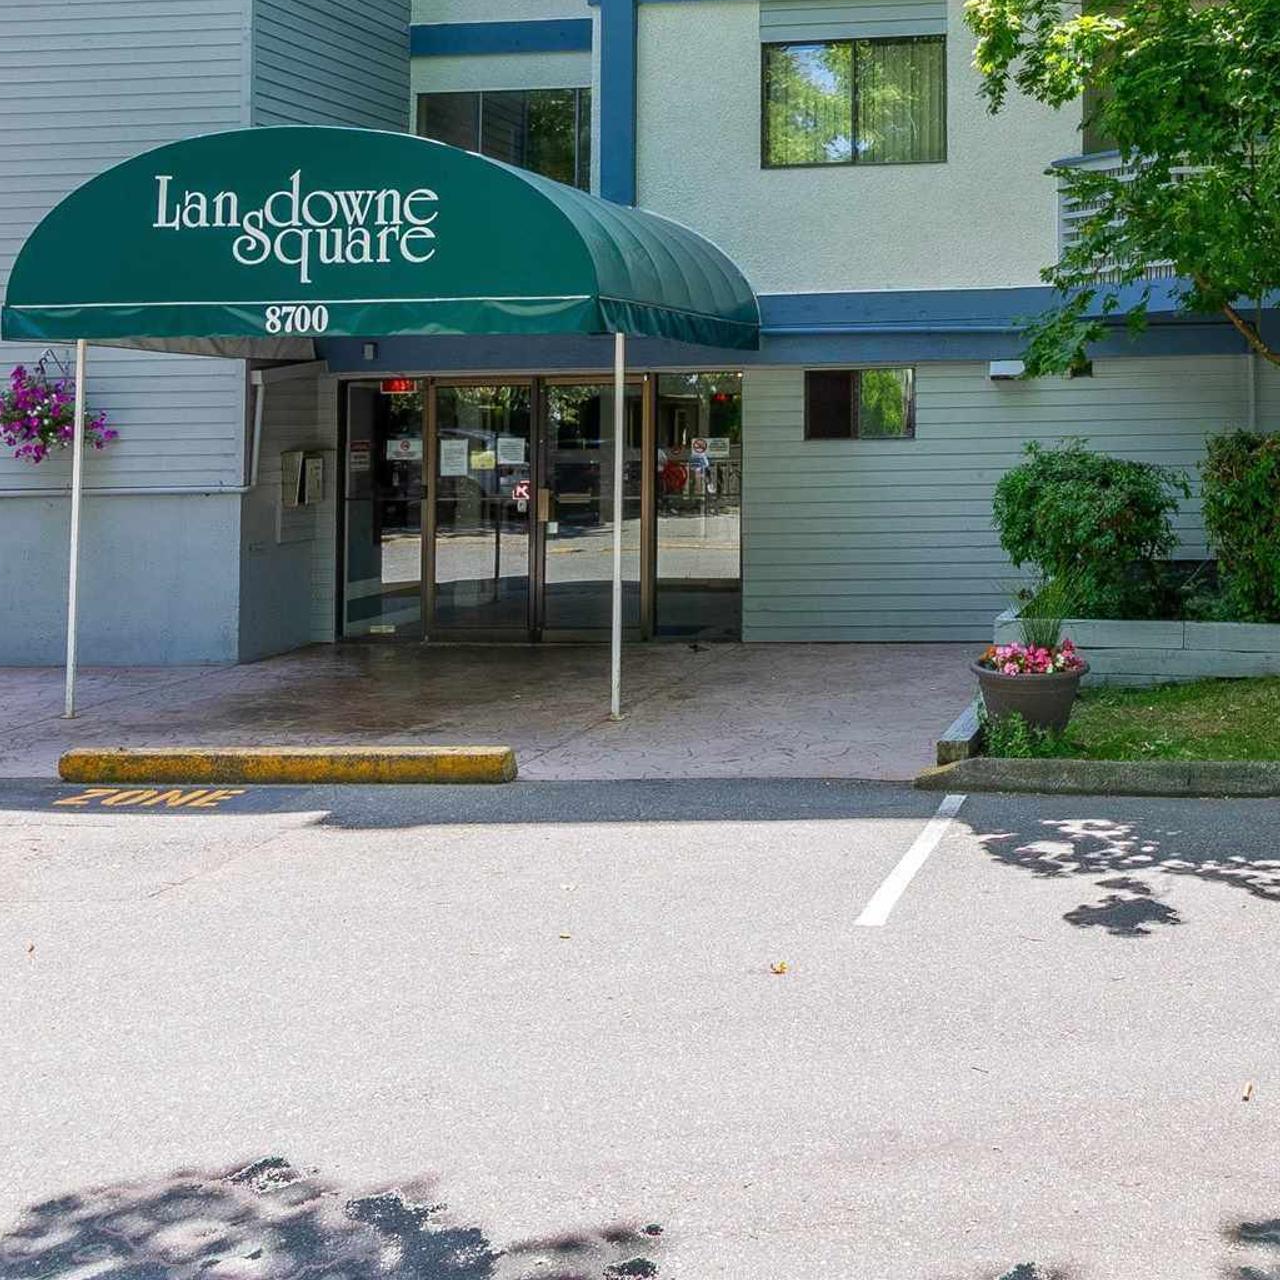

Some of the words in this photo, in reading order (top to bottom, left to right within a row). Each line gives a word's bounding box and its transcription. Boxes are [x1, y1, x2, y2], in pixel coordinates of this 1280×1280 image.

[152, 169, 439, 233] Lansdowne
[232, 207, 436, 283] Square
[265, 305, 329, 334] 8700
[52, 787, 246, 808] ZONE
